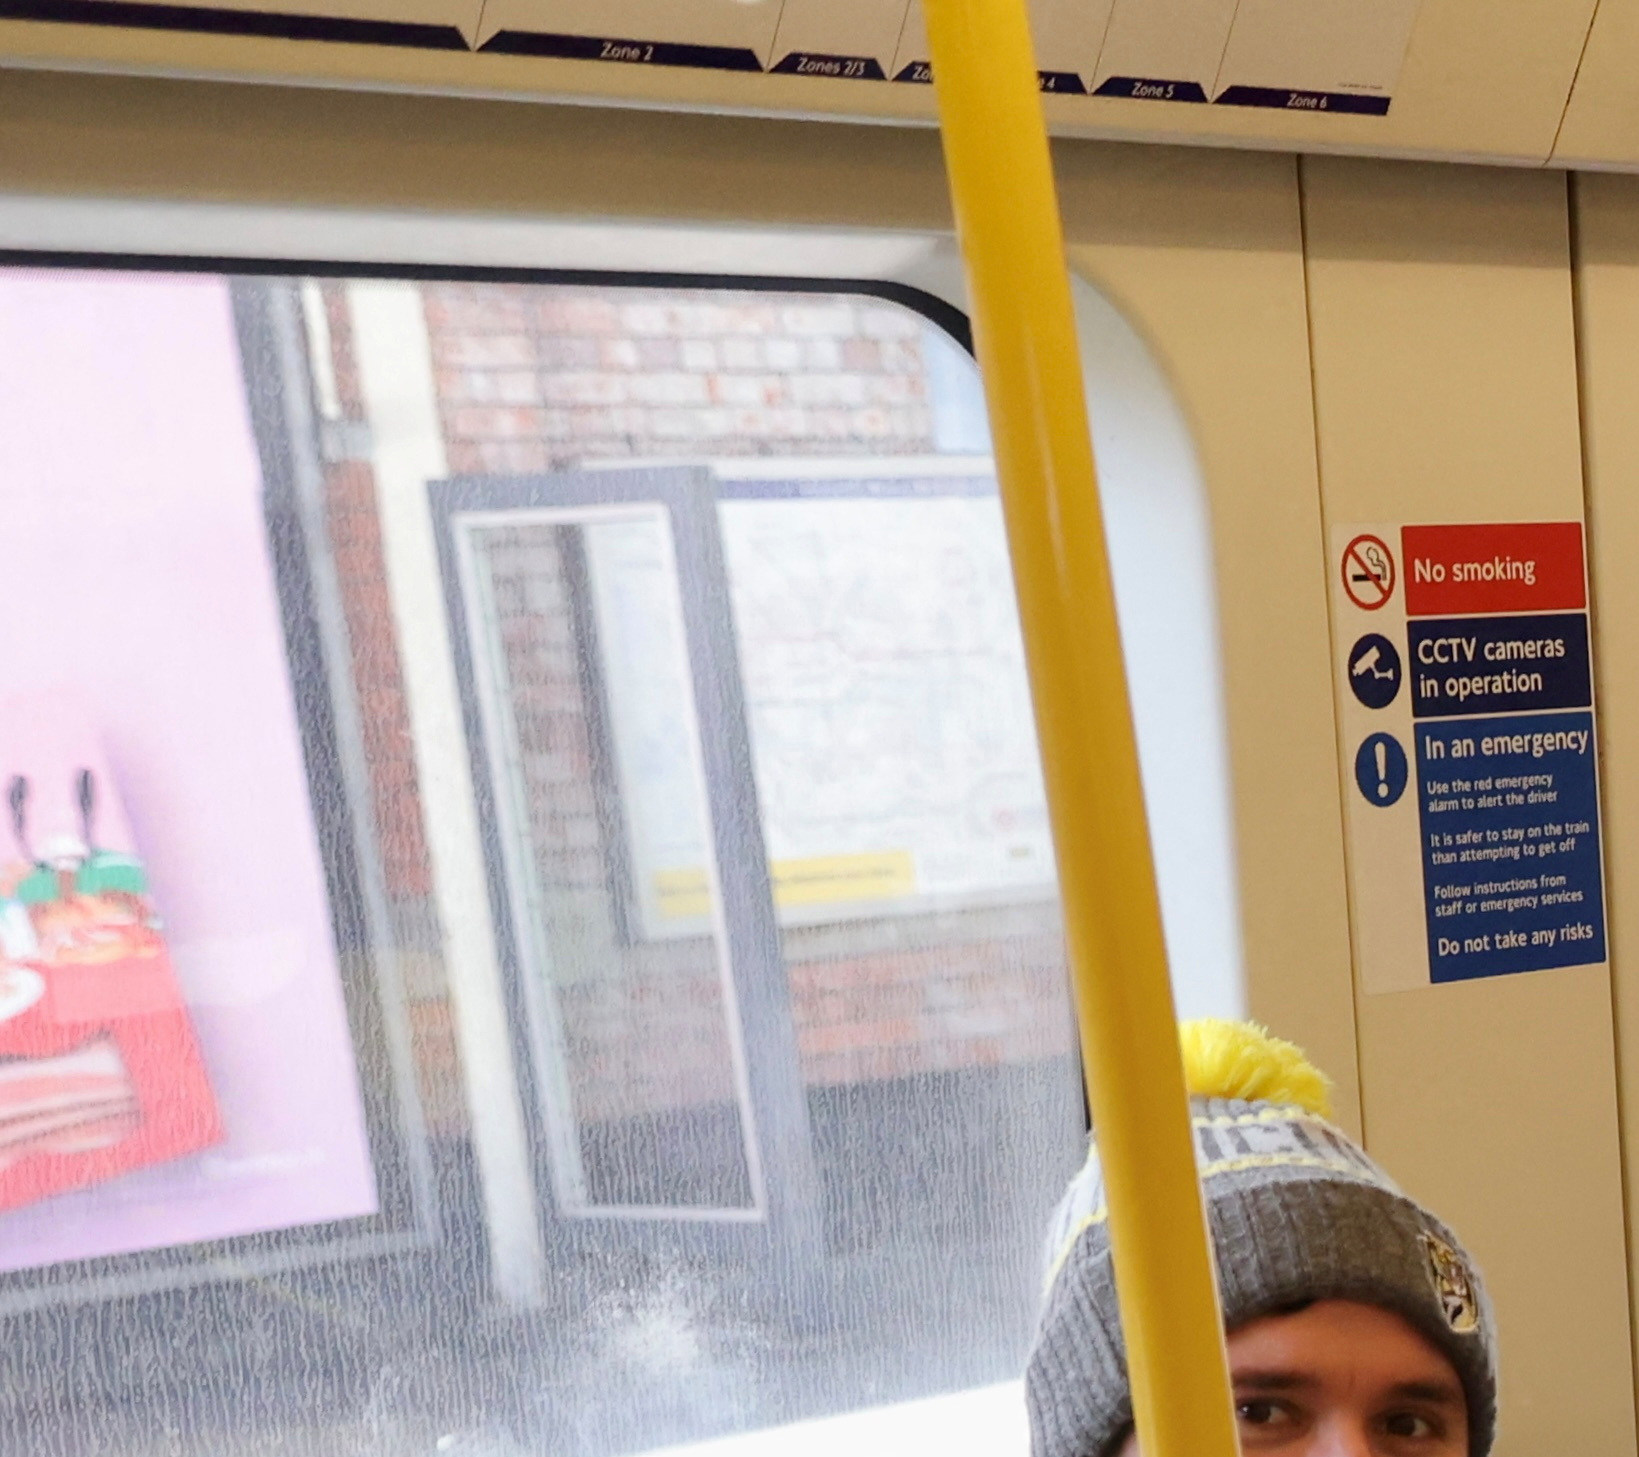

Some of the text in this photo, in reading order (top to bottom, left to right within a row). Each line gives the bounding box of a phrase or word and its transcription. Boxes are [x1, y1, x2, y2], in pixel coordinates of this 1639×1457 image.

[601, 41, 654, 62] Zone 2
[797, 57, 866, 76] Zones 2/3
[1046, 75, 1056, 89] 4
[1131, 81, 1175, 99] Zone 5
[1286, 92, 1328, 109] Zone 6
[1414, 556, 1536, 585] No smoking
[1418, 636, 1565, 664] CCTV cameras
[1419, 669, 1542, 702] in operation
[1425, 729, 1588, 759] In an emergency
[1427, 773, 1553, 794] Use the red emergency
[1428, 789, 1558, 813] alarm to alert the driver
[1431, 820, 1589, 848] It is safer to stay on the train
[1432, 838, 1576, 866] than attempting to get off
[1434, 874, 1566, 899] Follow instructions from
[1435, 889, 1584, 917] staff or emergency services
[1438, 922, 1593, 957] Do not take any risks
